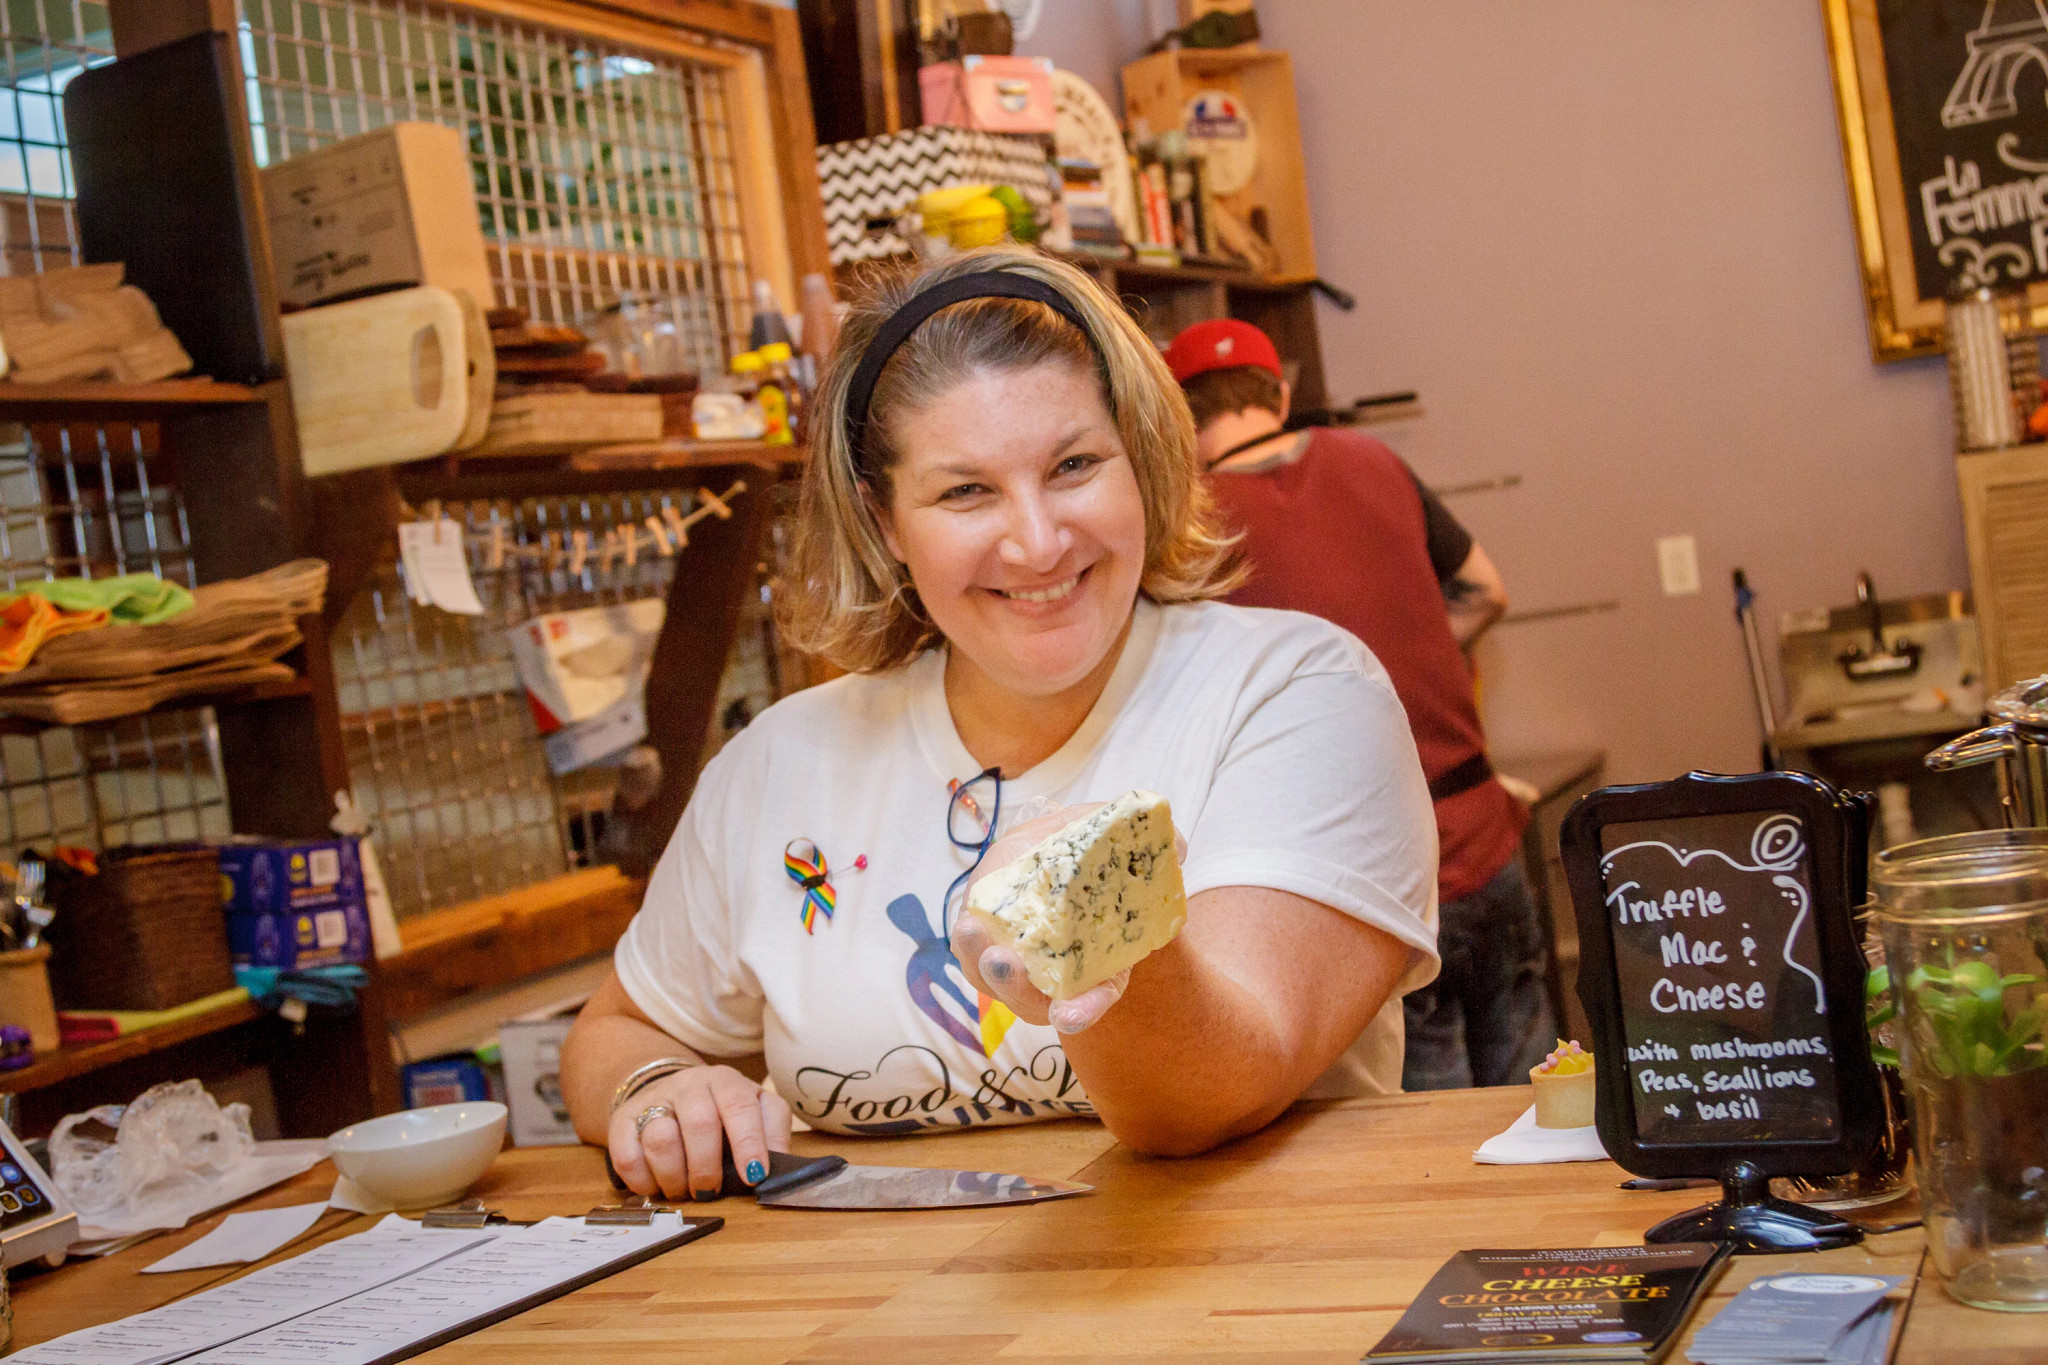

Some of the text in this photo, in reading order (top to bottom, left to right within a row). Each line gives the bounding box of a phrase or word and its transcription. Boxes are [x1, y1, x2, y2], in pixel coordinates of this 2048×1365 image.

[1605, 880, 1726, 925] Truffle
[1659, 931, 1728, 968] Mac
[1650, 977, 1766, 1013] Cheese
[1627, 1038, 1679, 1062] with
[795, 1045, 959, 1122] Food
[1638, 1069, 1700, 1094] Peas,
[1695, 1093, 1761, 1121] basil
[1482, 1273, 1647, 1291] CHEESE
[1522, 1263, 1631, 1277] WINE
[1438, 1286, 1672, 1306] CHOCOLATE
